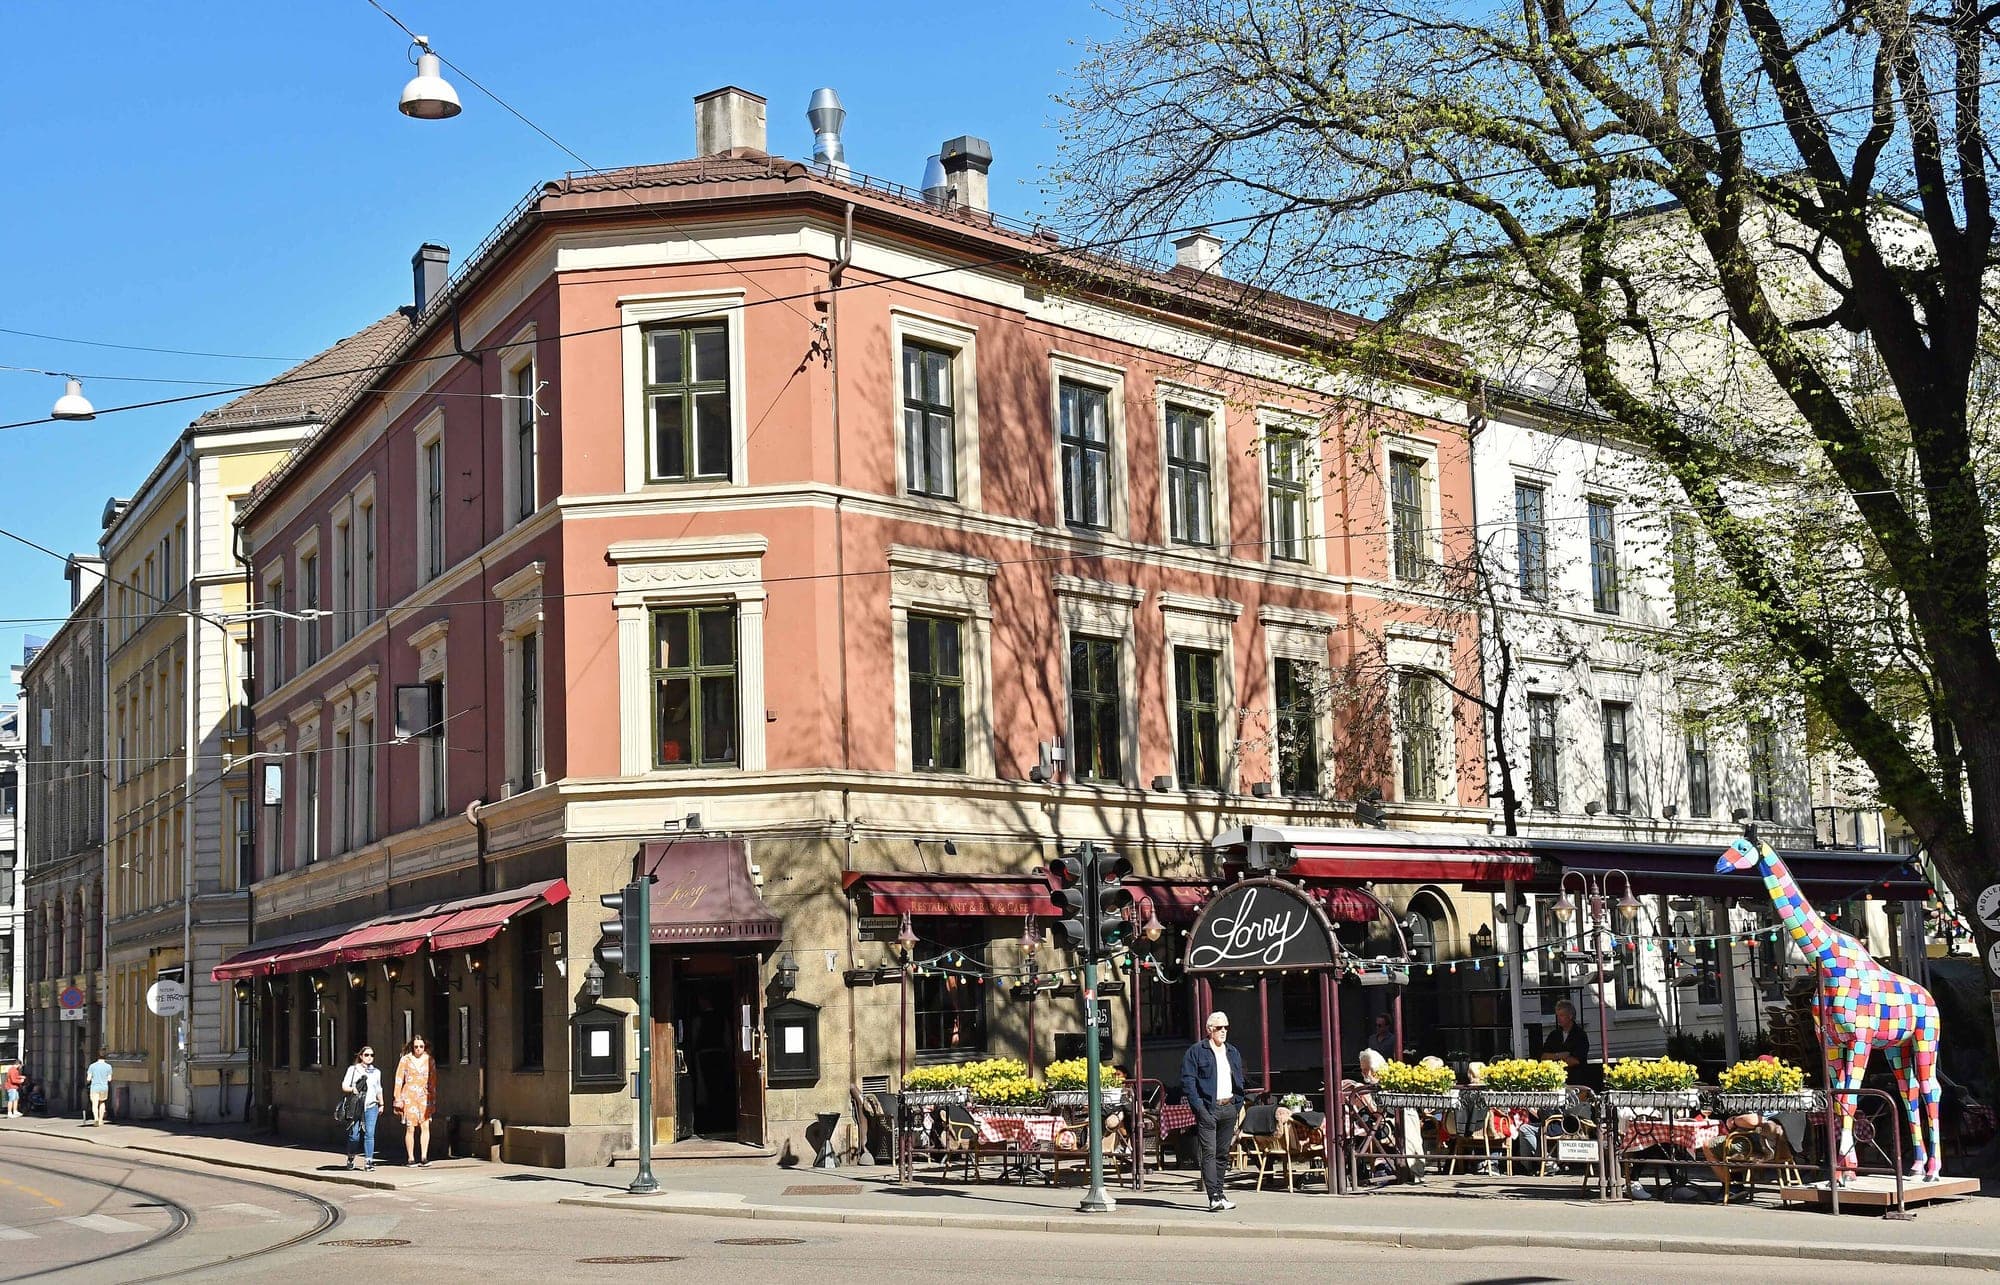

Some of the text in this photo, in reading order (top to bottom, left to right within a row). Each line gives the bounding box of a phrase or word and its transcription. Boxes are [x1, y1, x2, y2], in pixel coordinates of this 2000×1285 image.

[911, 901, 967, 912] RESTAURANT
[969, 901, 977, 912] &
[997, 902, 1005, 913] &
[1190, 888, 1309, 968] Lorry
